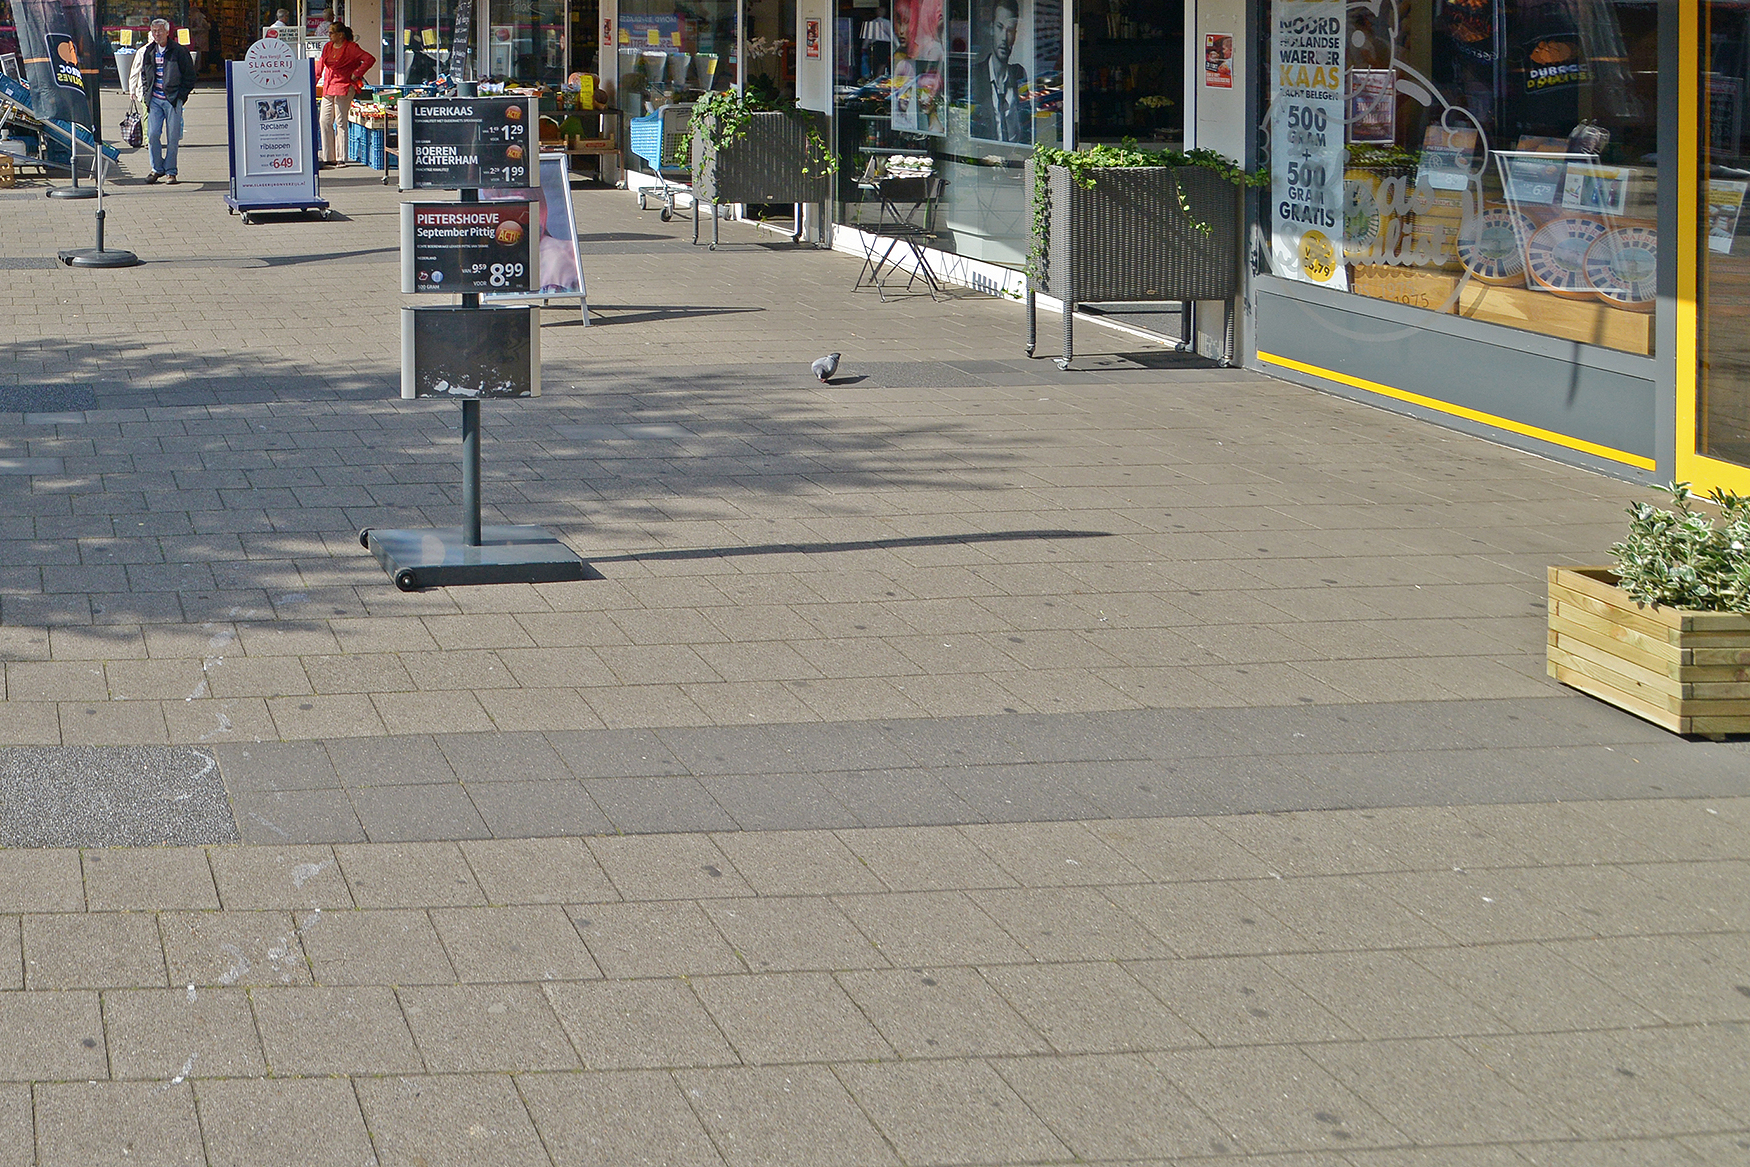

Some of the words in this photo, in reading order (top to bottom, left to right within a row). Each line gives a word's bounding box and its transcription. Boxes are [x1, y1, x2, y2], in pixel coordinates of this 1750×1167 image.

[1280, 17, 1340, 34] NOORD
[248, 61, 293, 69] SLAGERIJ
[1280, 64, 1339, 90] KAAS
[1306, 90, 1338, 100] BELEGEN
[415, 106, 473, 116] LEVERKAAS
[1288, 106, 1327, 132] 500
[260, 123, 289, 131] Reclame
[501, 125, 524, 140] 1.29
[416, 147, 456, 156] BOEREN
[416, 156, 478, 165] ACHTERHAM
[502, 167, 524, 182] 1.99
[1288, 162, 1325, 189] 500
[417, 214, 499, 224] PIETERSHOEVE
[1279, 202, 1336, 228] GRATIS
[417, 227, 469, 239] September
[470, 227, 496, 238] Pittig
[490, 263, 524, 287] 8.99
